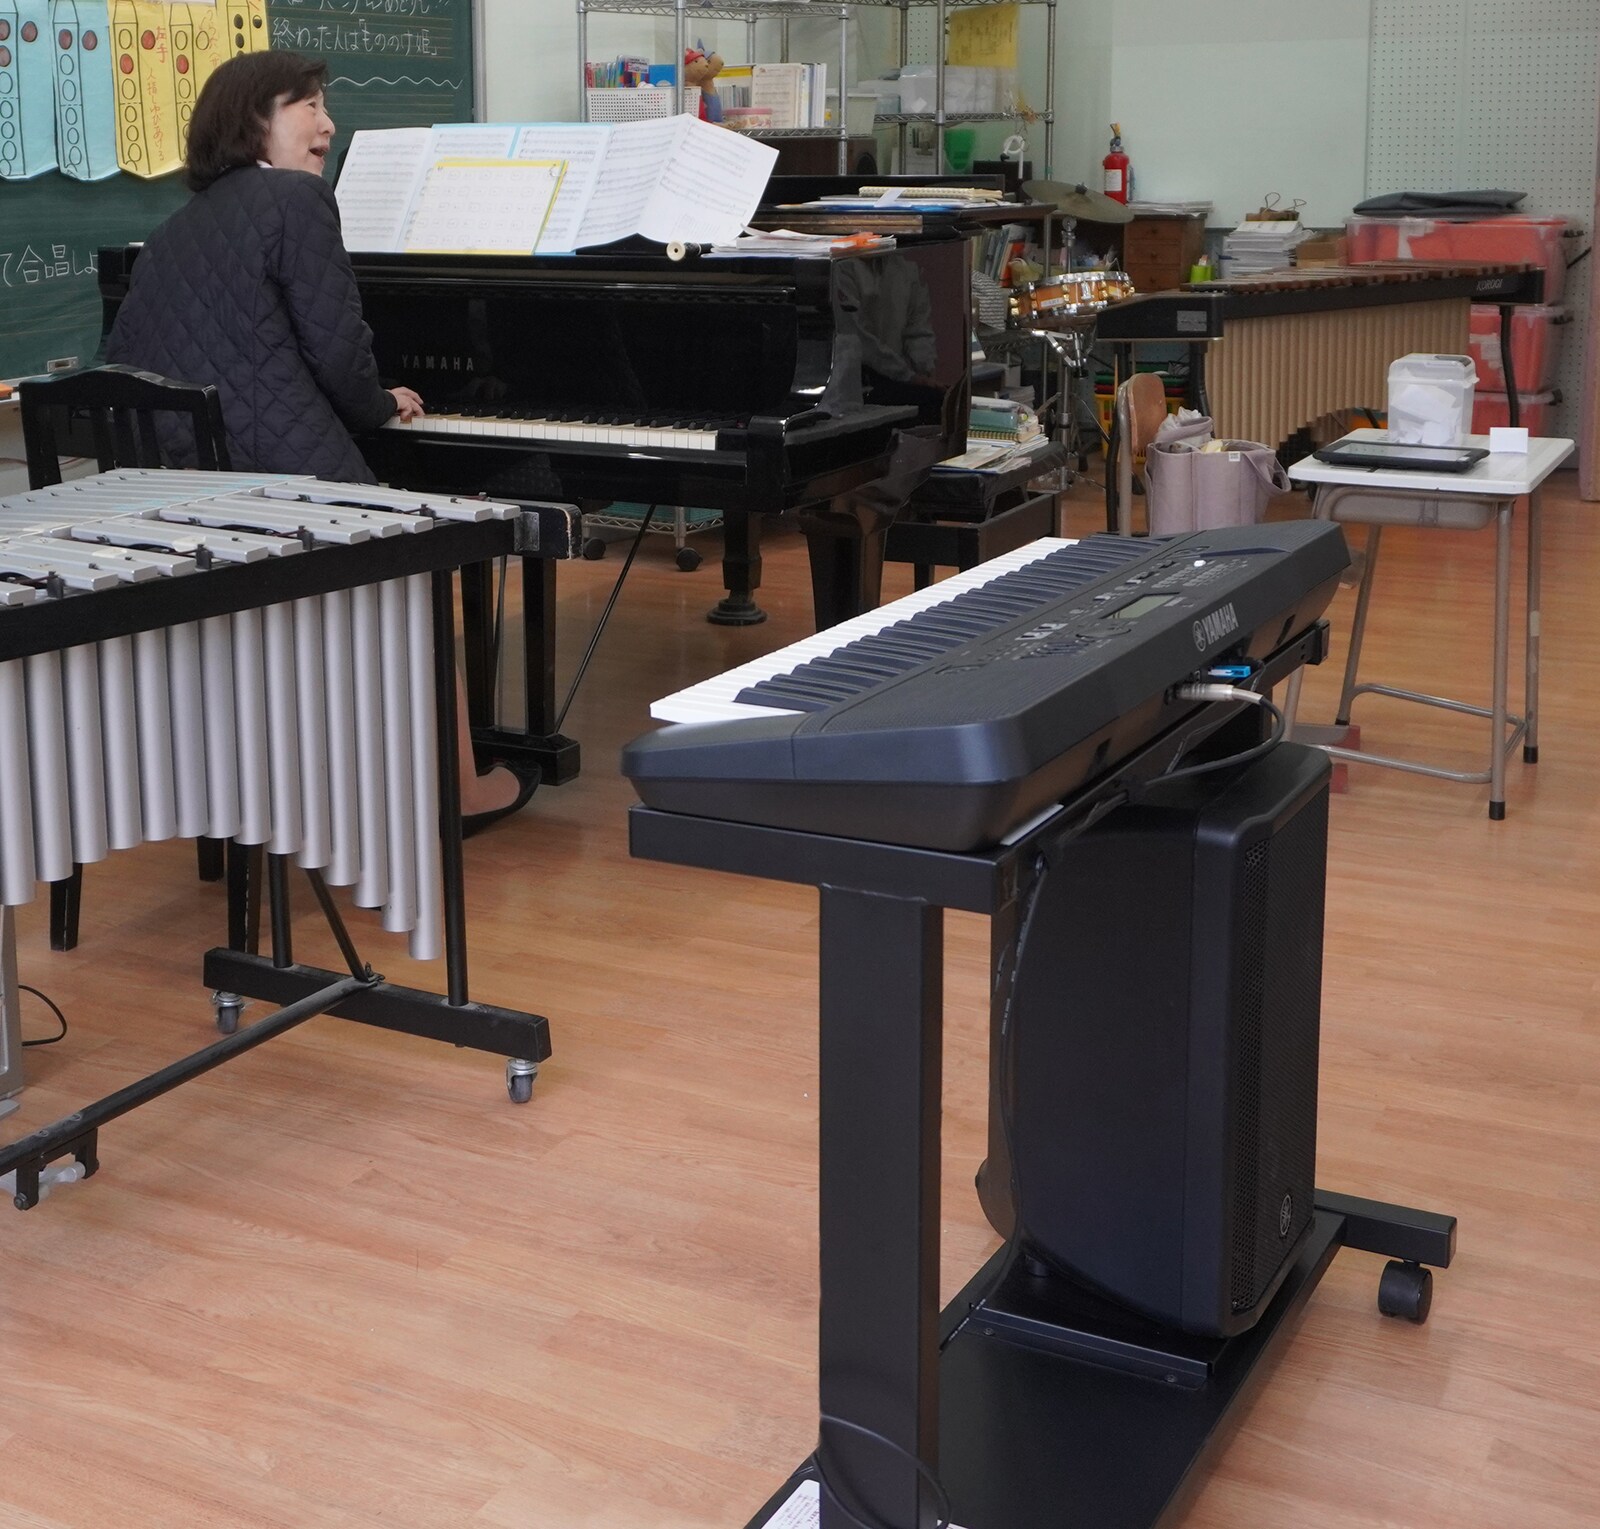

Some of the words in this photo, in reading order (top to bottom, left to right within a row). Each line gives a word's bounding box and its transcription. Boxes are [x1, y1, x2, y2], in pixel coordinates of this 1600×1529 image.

[155, 26, 168, 63] 左手
[402, 354, 473, 370] YAMAHA
[1201, 602, 1239, 645] YAMAHA
